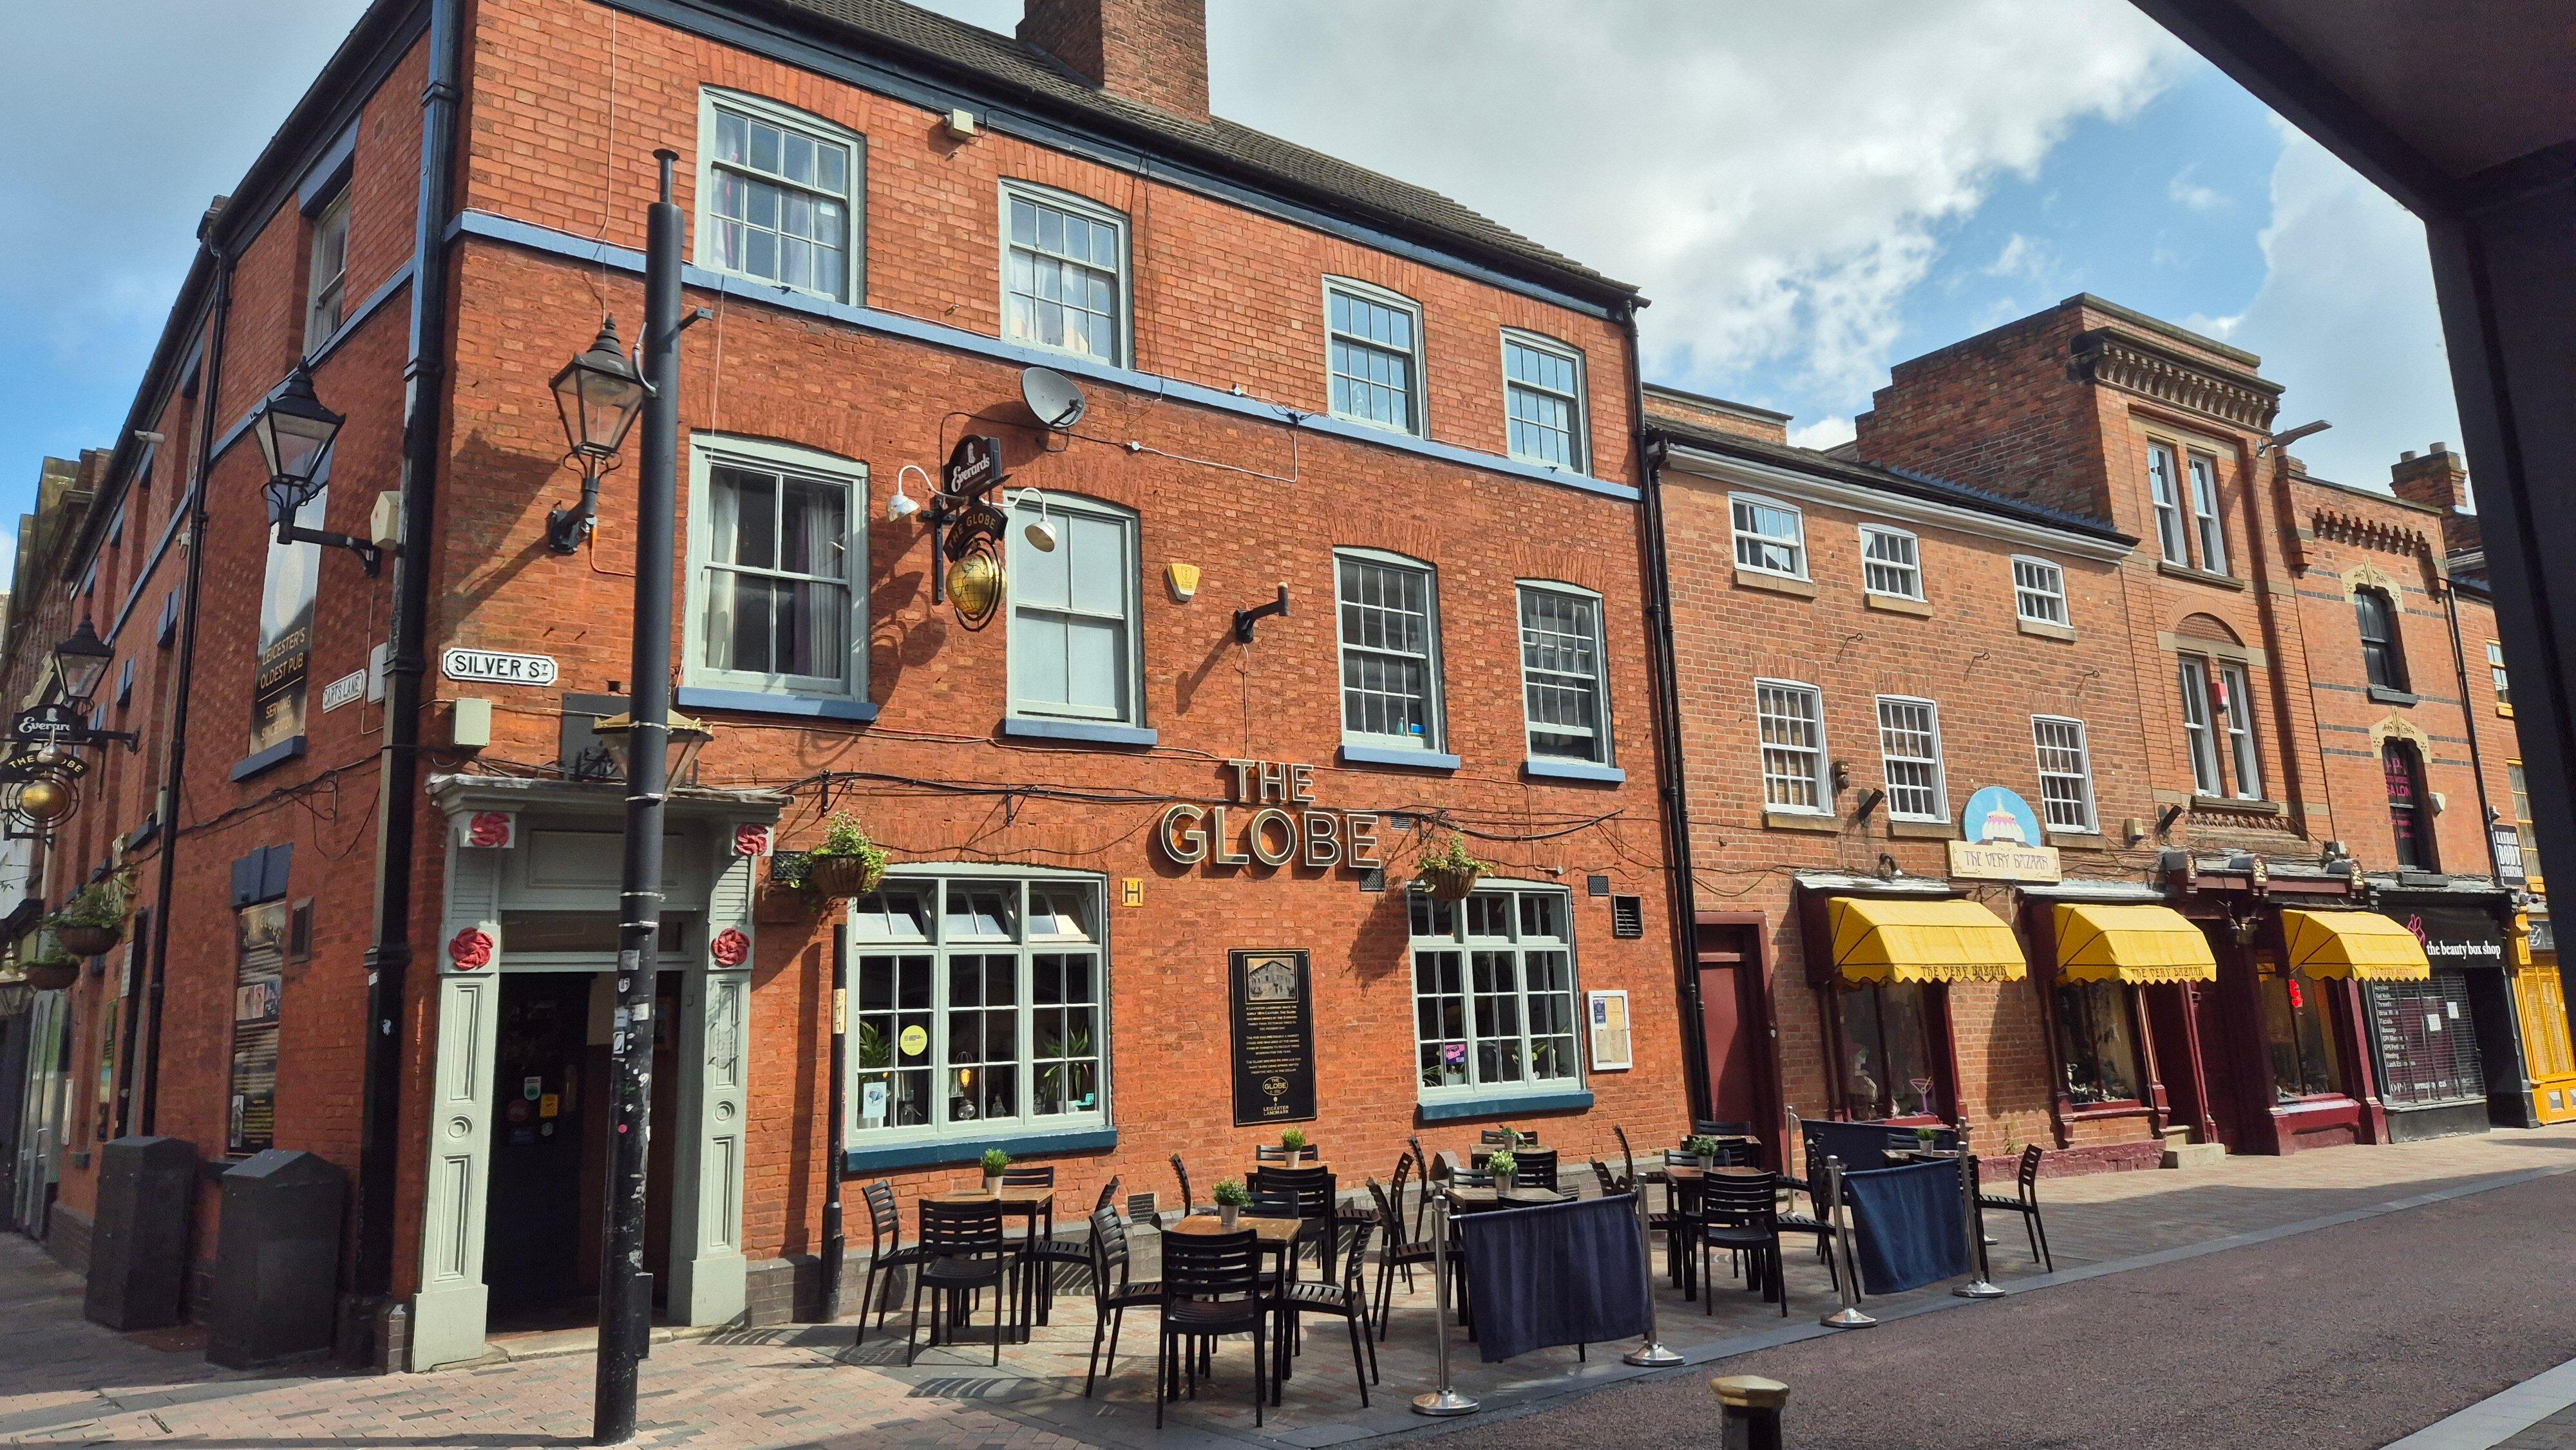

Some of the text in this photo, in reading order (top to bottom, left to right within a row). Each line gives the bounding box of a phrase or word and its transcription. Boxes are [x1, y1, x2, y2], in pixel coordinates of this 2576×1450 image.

[951, 453, 990, 493] Everards
[949, 513, 996, 549] THE GLOBE
[263, 627, 305, 665] LEICESTER'S
[261, 652, 303, 689] OLDEST PUB
[455, 654, 521, 677] SILVER
[325, 675, 360, 706] CARTS LANE
[266, 694, 292, 719] SERVING
[8, 755, 35, 769] THE
[1229, 758, 1316, 802] THE
[1160, 804, 1381, 869] GLOBE
[1985, 851, 2009, 868] VERY
[2014, 854, 2049, 870] BAZAAR
[2497, 844, 2522, 865] BODY
[2501, 865, 2524, 877] PIERCING
[1125, 881, 1140, 903] H
[2426, 940, 2501, 959] the beauty box shop
[1920, 965, 2007, 978] THE VERY BAZAAR
[2131, 967, 2204, 978] THE VERY BAZAAR
